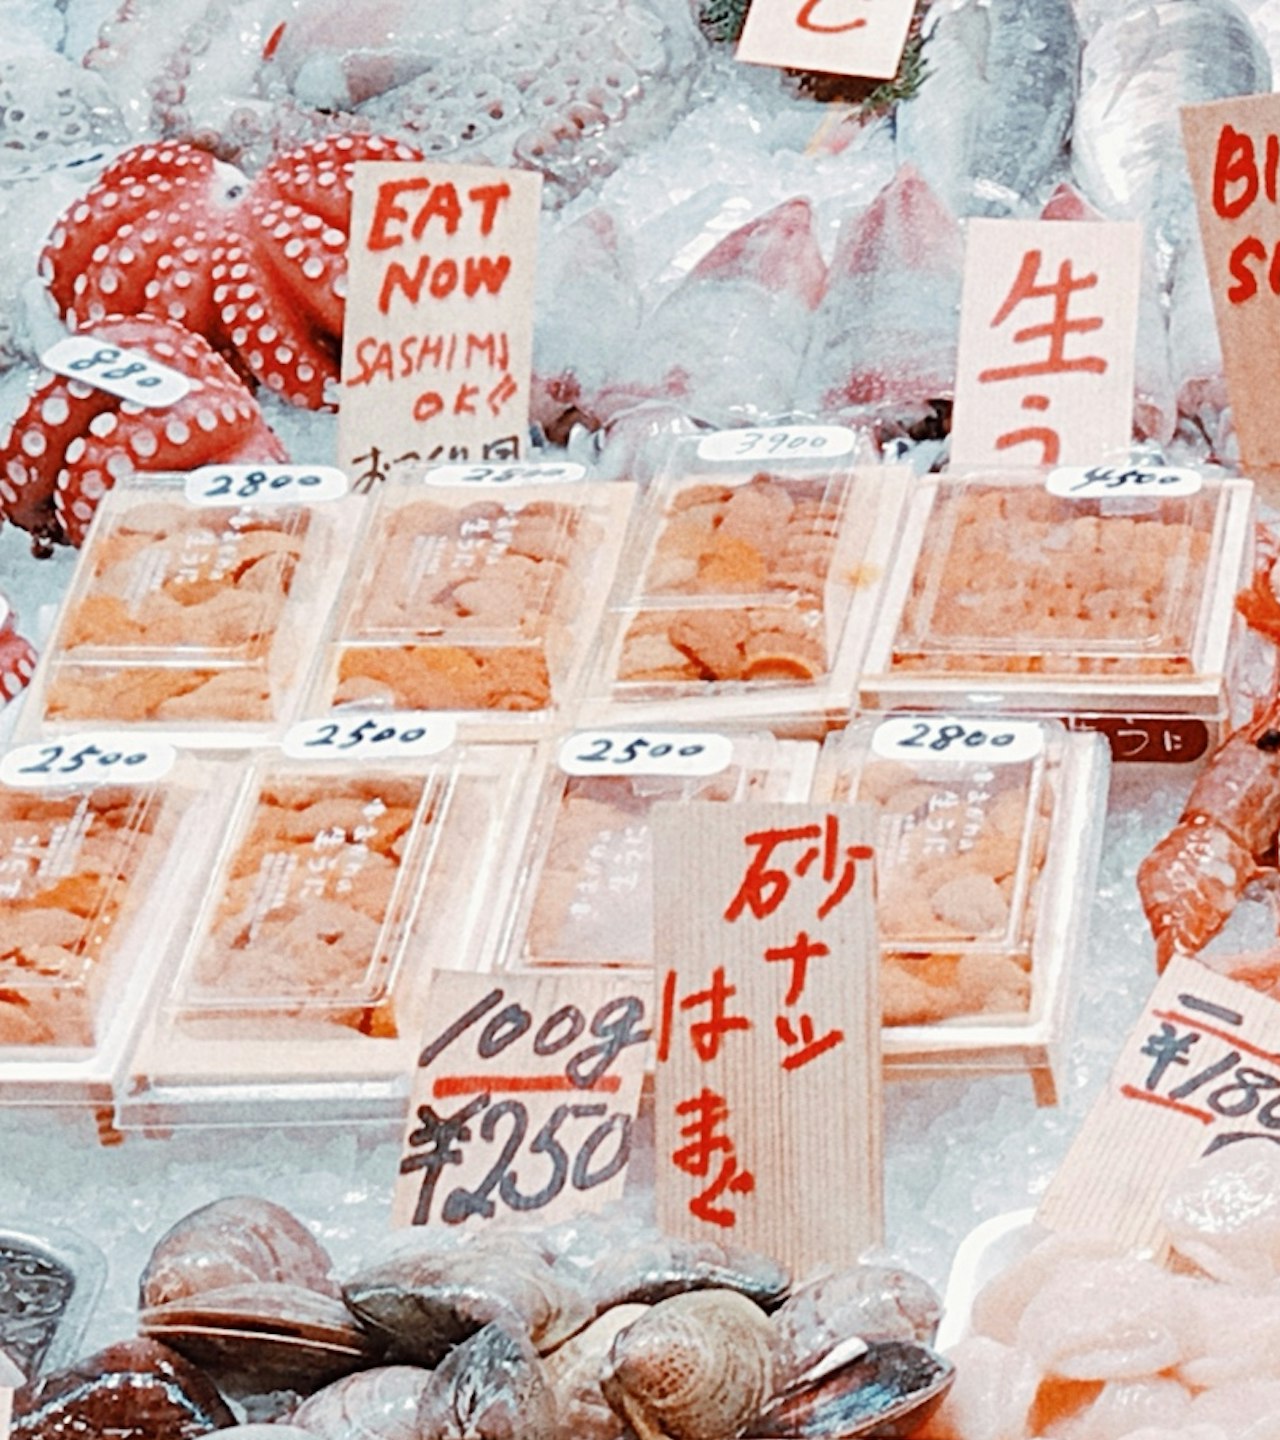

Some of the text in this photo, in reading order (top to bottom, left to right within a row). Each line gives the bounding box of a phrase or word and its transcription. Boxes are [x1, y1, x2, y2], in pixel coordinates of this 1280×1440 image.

[366, 177, 511, 251] EAT
[378, 254, 511, 315] NOW
[346, 332, 509, 387] SASHIMI
[203, 470, 322, 498] 2800
[304, 718, 428, 750] 2500
[575, 738, 707, 764] 2500
[897, 723, 1016, 752] 2800
[18, 746, 147, 775] 2500
[418, 988, 652, 1089] 100g
[400, 1093, 632, 1226] ¥250
